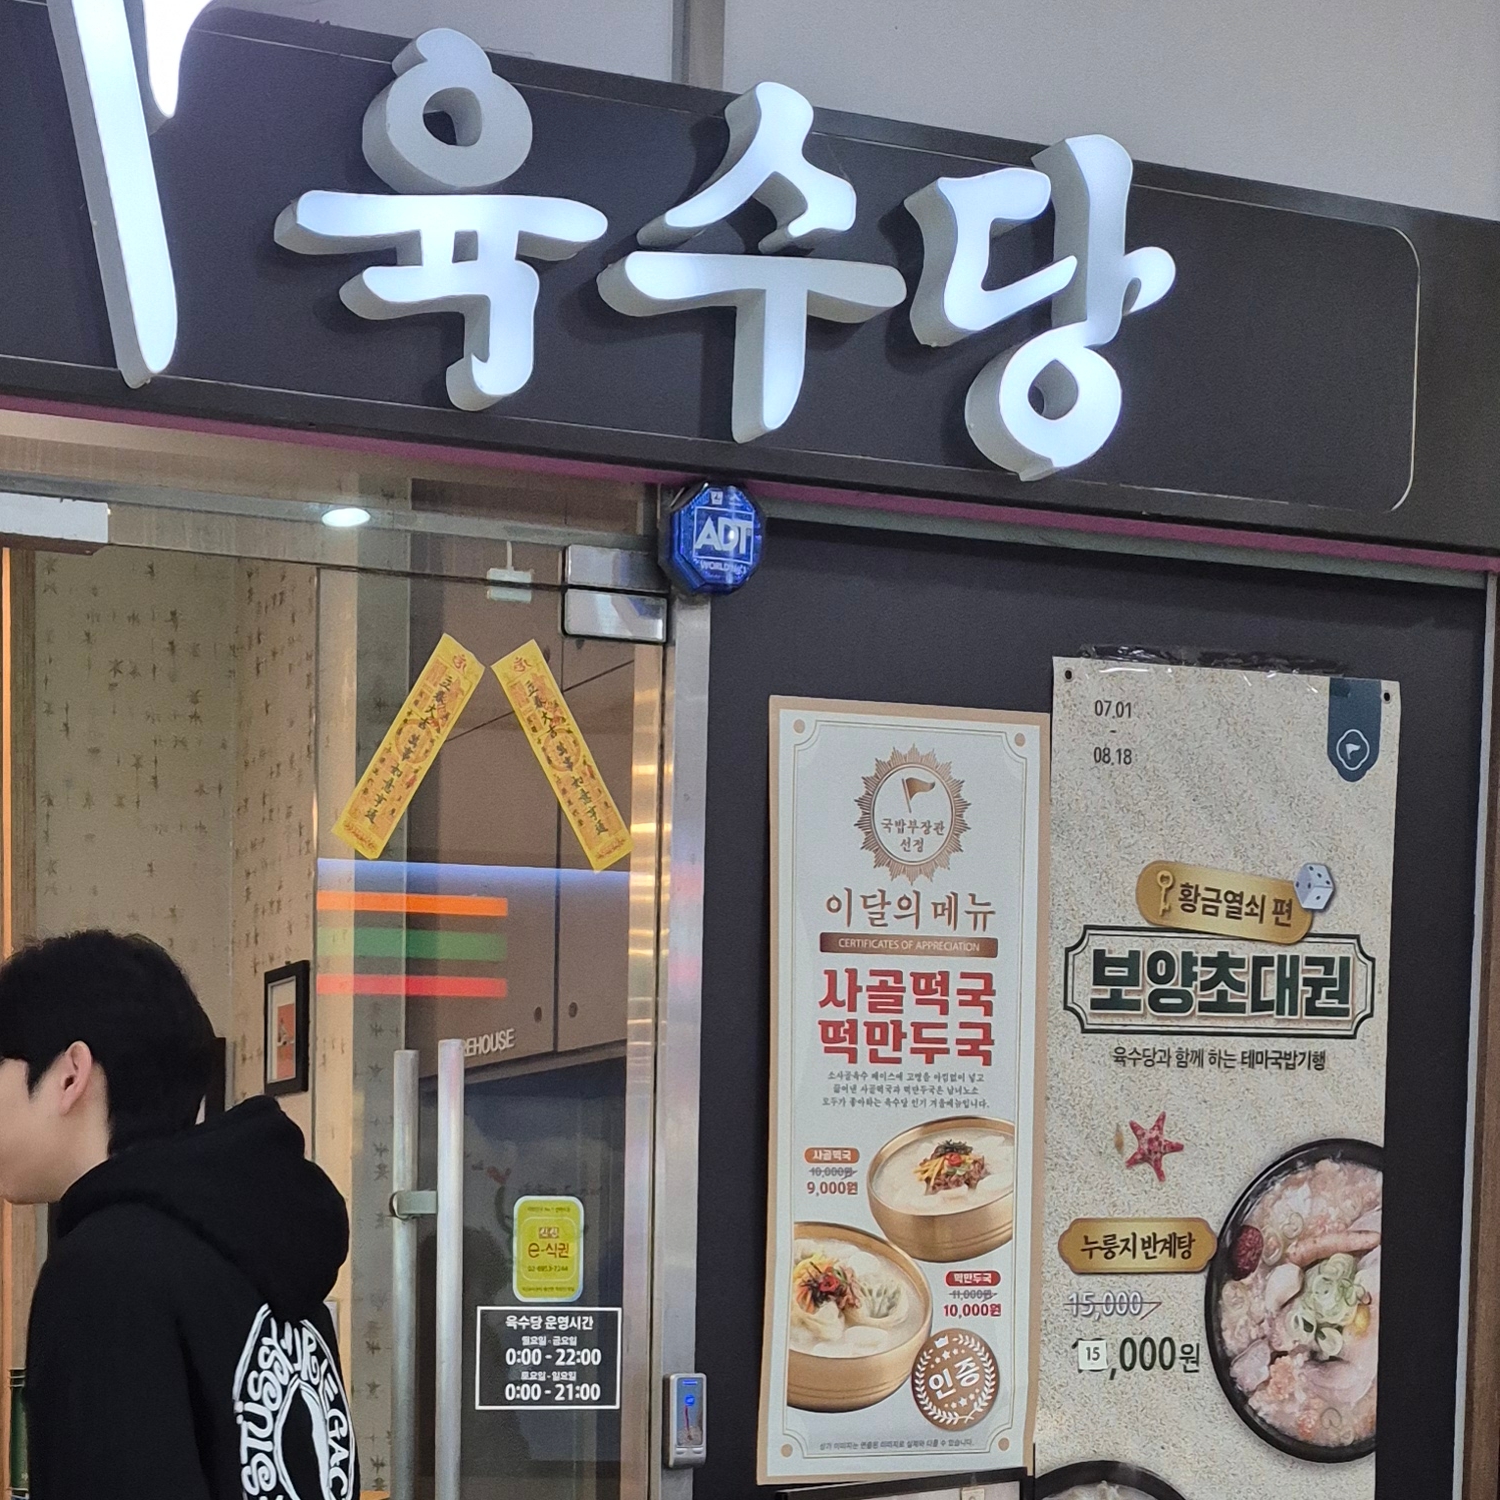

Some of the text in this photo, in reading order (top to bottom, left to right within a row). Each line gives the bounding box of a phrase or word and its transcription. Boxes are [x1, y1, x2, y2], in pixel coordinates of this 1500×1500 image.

[274, 28, 1176, 481] 육수당
[695, 516, 753, 554] ADT
[1095, 700, 1131, 718] 07.01
[1094, 746, 1132, 765] 08.18
[881, 817, 945, 836] 국밥부장관
[900, 837, 924, 853] 선정
[826, 887, 996, 933] 이달의 메뉴
[1178, 881, 1293, 928] 황금열쇠 편
[838, 937, 980, 952] CERTIFICATES OF APPRECIATION
[818, 968, 997, 1017] 사골떡국
[1089, 948, 1352, 1018] 보양초대권
[464, 1027, 516, 1057] EHOUSE
[818, 1018, 996, 1066] 떡만두국
[1112, 1046, 1326, 1071] 육수당과 함께 하는 테마국밥기행
[807, 1181, 858, 1197] 9,000원
[528, 1243, 570, 1258] e-식권
[1081, 1232, 1196, 1260] 누룽지 반계탕
[943, 1303, 1001, 1318] 10,000원
[1069, 1291, 1143, 1320] 15,000
[505, 1315, 594, 1331] 육수당 운영시간
[505, 1348, 542, 1365] 0:00
[555, 1348, 602, 1366] 22:00
[928, 1356, 980, 1400] 인증
[505, 1383, 541, 1400] 0:00
[554, 1383, 601, 1401] 21:00
